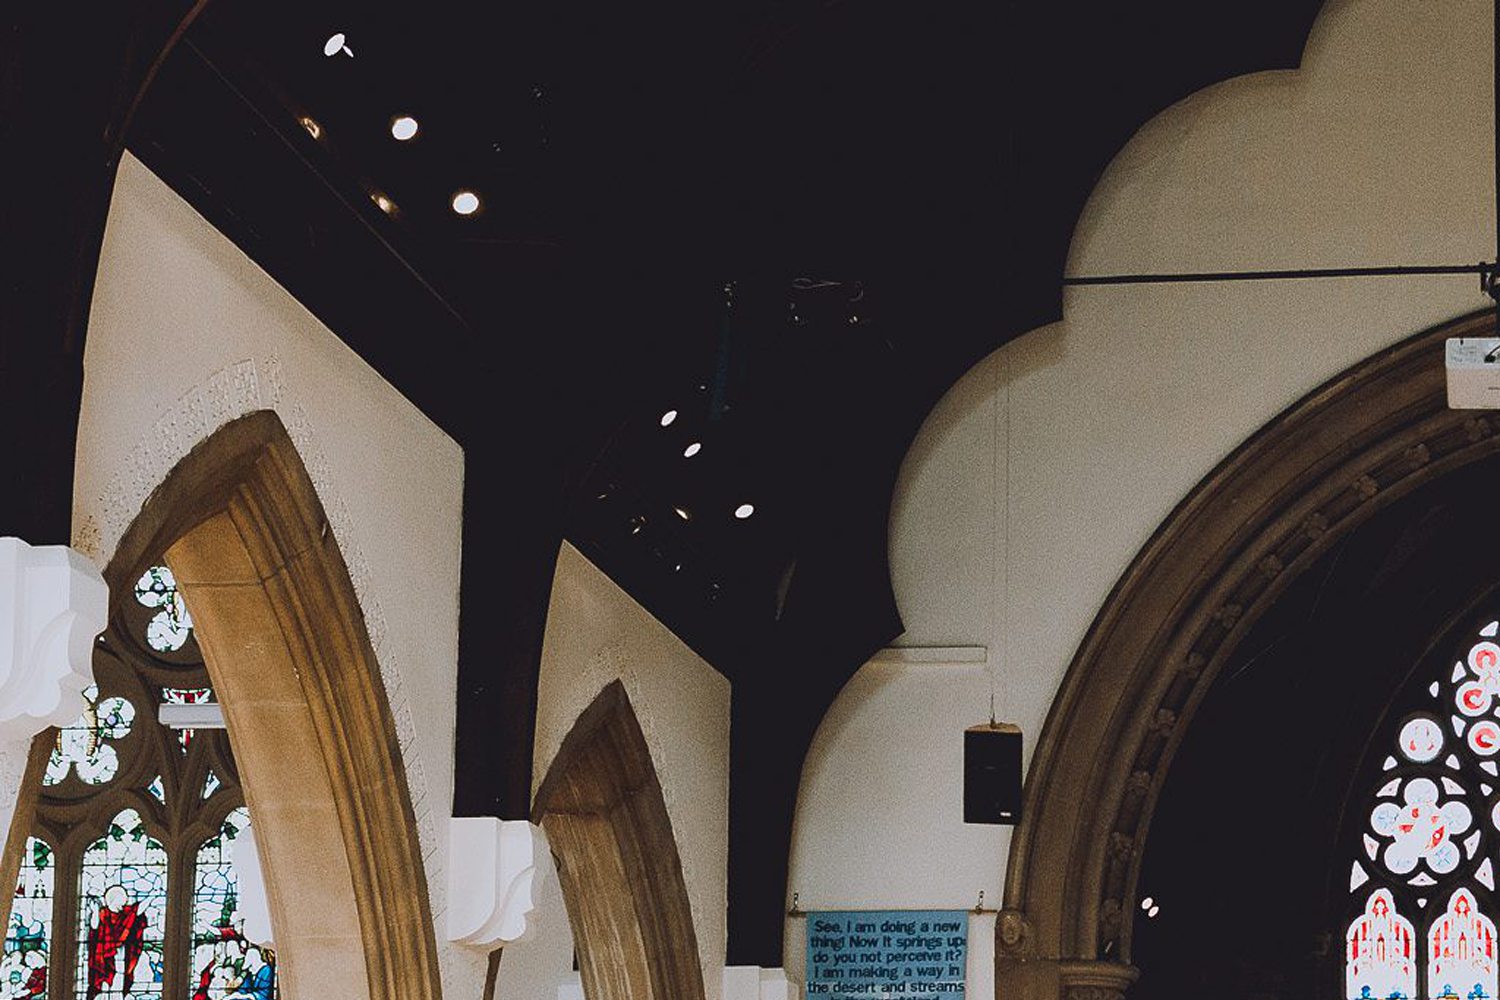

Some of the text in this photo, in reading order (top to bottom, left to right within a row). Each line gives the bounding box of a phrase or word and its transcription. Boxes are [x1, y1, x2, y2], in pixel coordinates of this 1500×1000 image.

[846, 919, 852, 933] I
[855, 922, 877, 933] am
[880, 919, 916, 936] doing
[920, 922, 930, 933] a
[933, 922, 961, 933] new
[849, 935, 879, 948] Now
[896, 934, 943, 951] springs
[813, 948, 963, 967] do you not perceive it?
[814, 963, 960, 981] I am making a way in
[807, 980, 966, 994] the desert and streams
